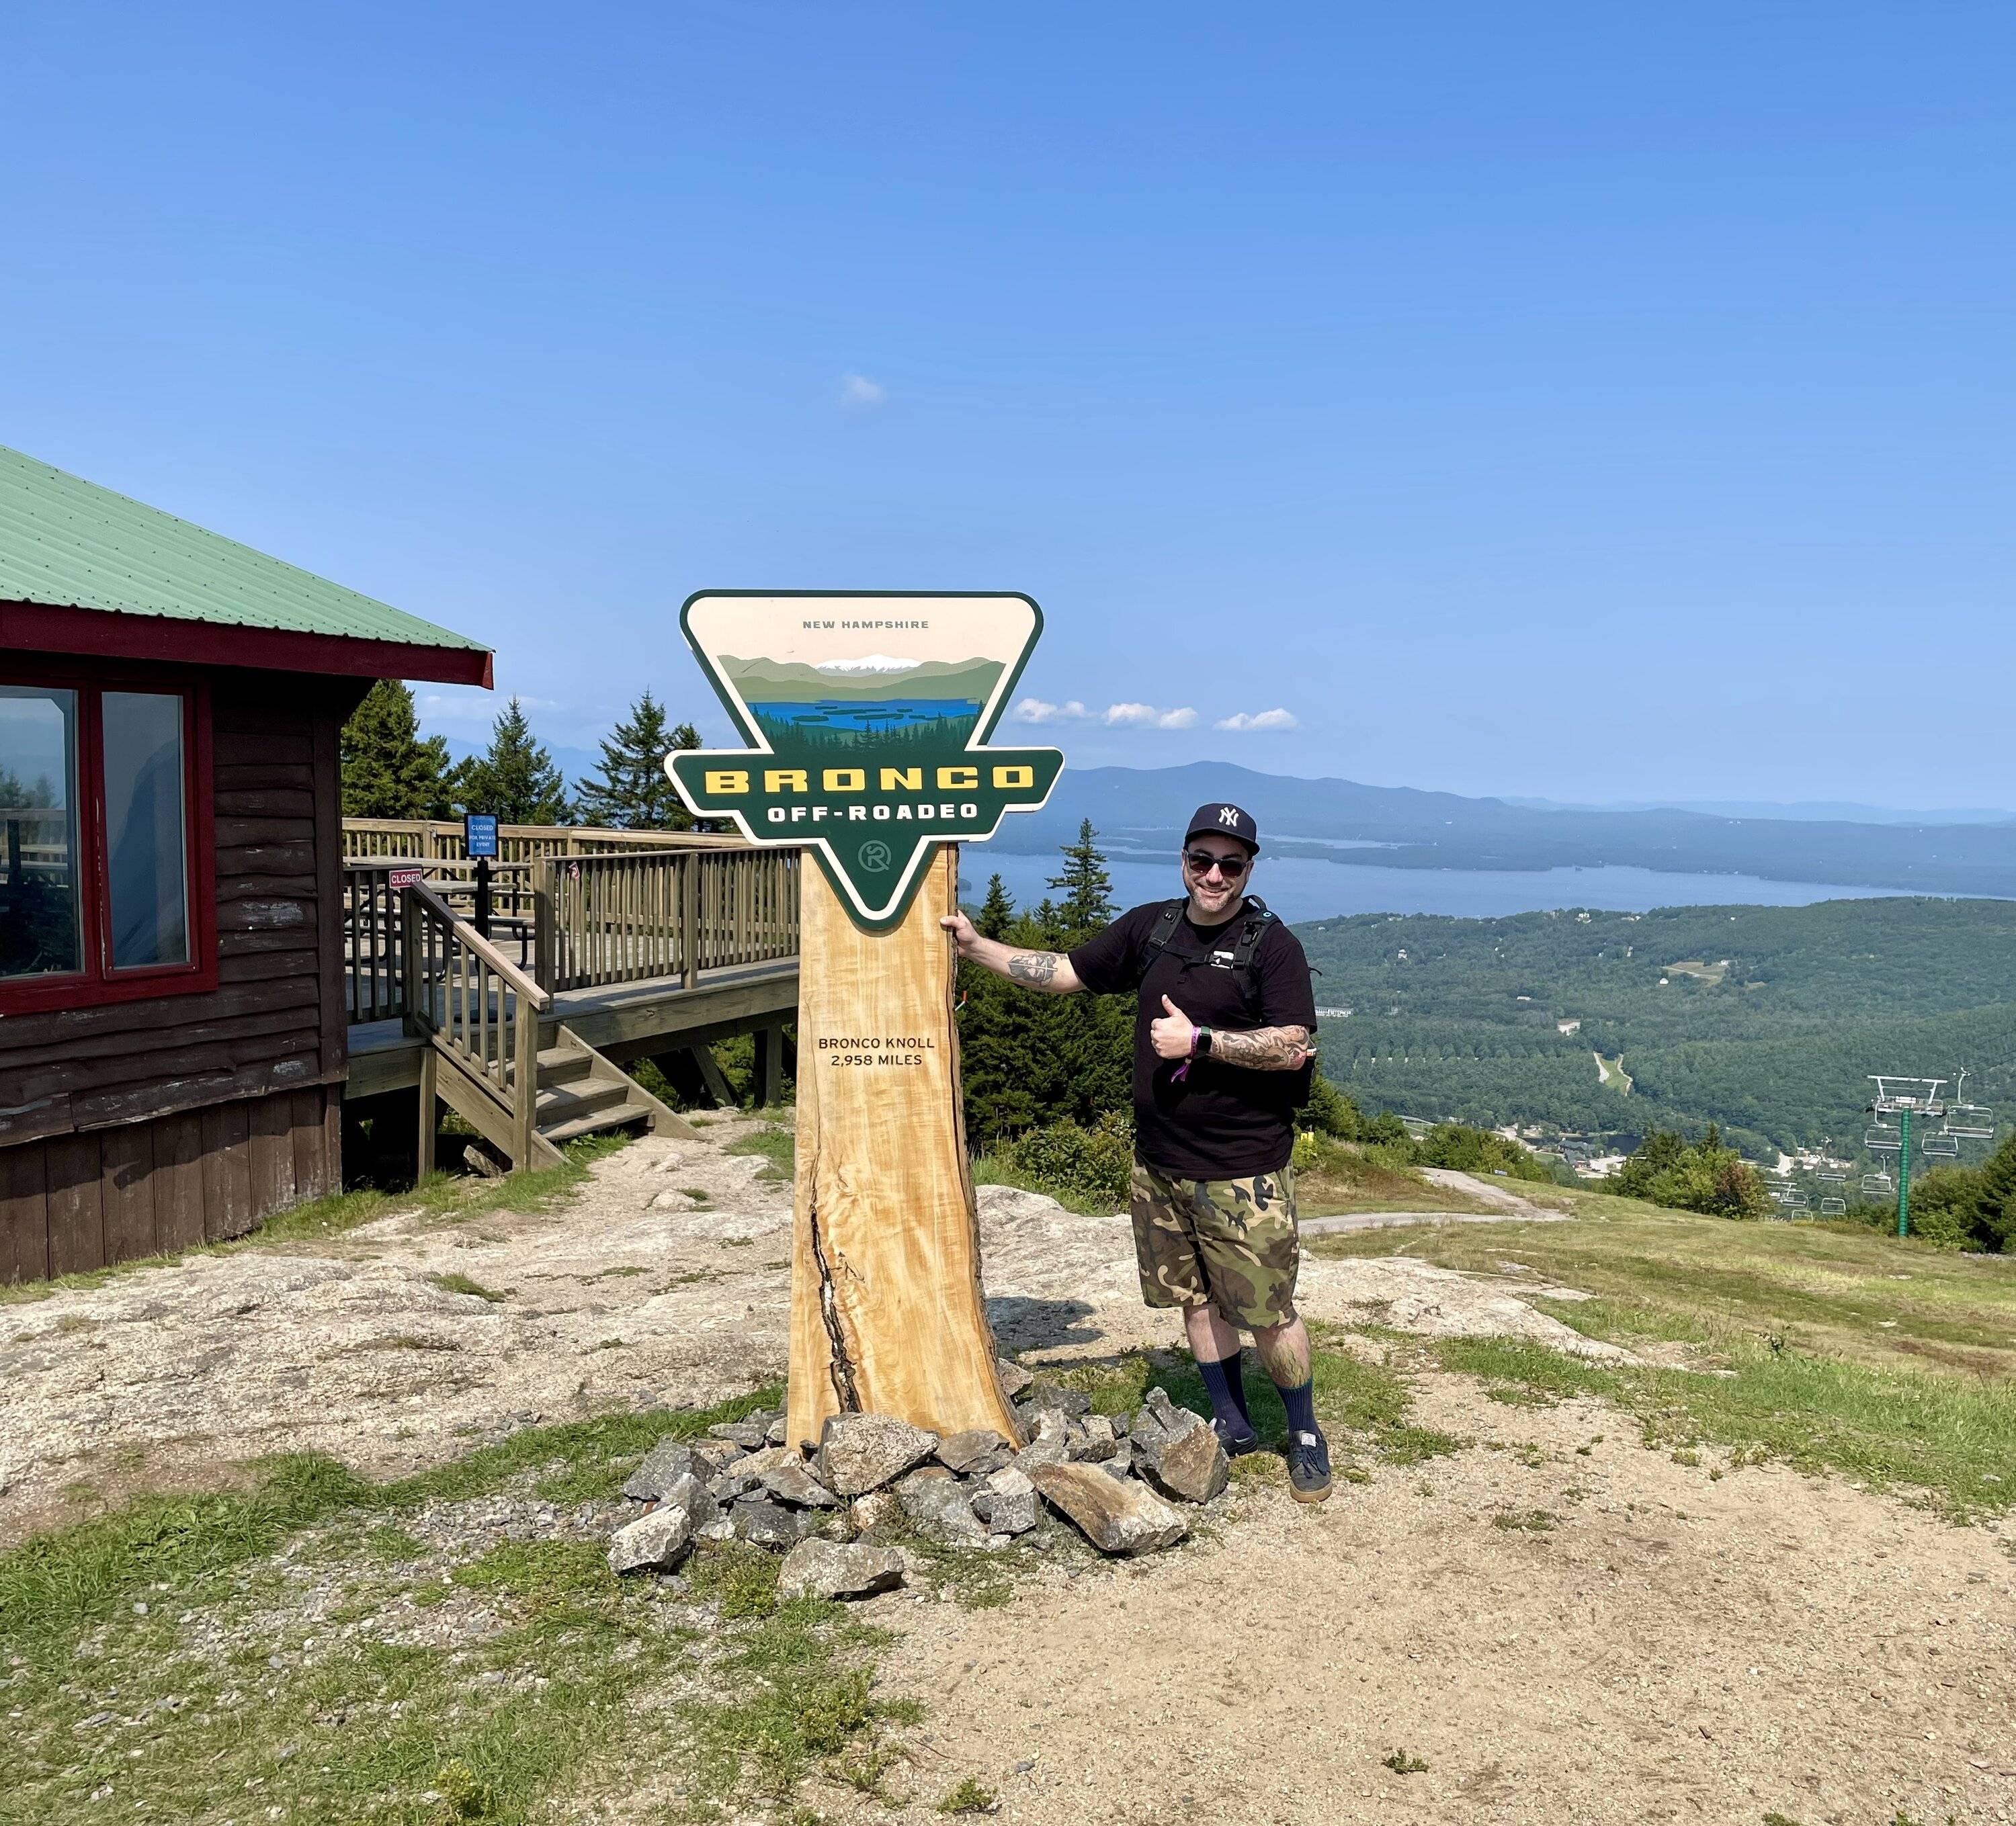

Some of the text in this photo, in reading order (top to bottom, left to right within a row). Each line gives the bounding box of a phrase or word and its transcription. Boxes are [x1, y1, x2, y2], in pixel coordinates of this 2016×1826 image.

[803, 621, 929, 629] NEW HAMPSHIRE
[705, 765, 1034, 794] BRONCO
[767, 803, 978, 822] OFF-ROADEO
[1218, 807, 1239, 827] NY
[391, 873, 421, 884] CLOSED
[818, 1038, 935, 1049] BRONCO KNOLL
[831, 1055, 922, 1067] 2,958 MILES
